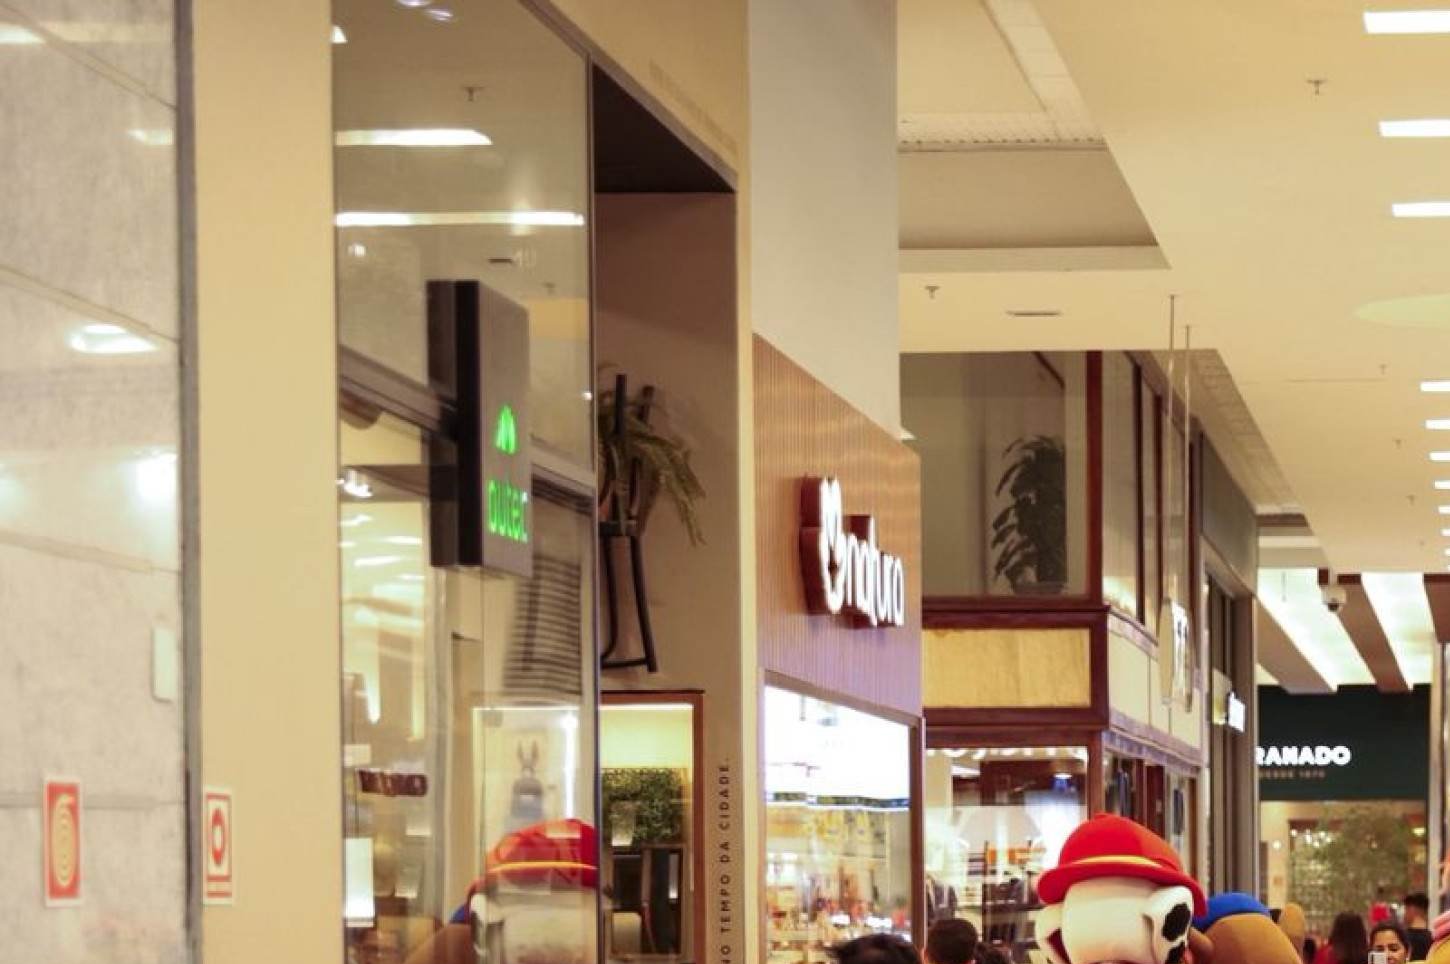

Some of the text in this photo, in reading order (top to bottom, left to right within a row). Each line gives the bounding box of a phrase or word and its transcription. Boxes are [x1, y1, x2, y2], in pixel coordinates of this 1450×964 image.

[1256, 745, 1352, 766] RANADO
[718, 841, 731, 863] DA
[719, 873, 732, 934] TEMPO
